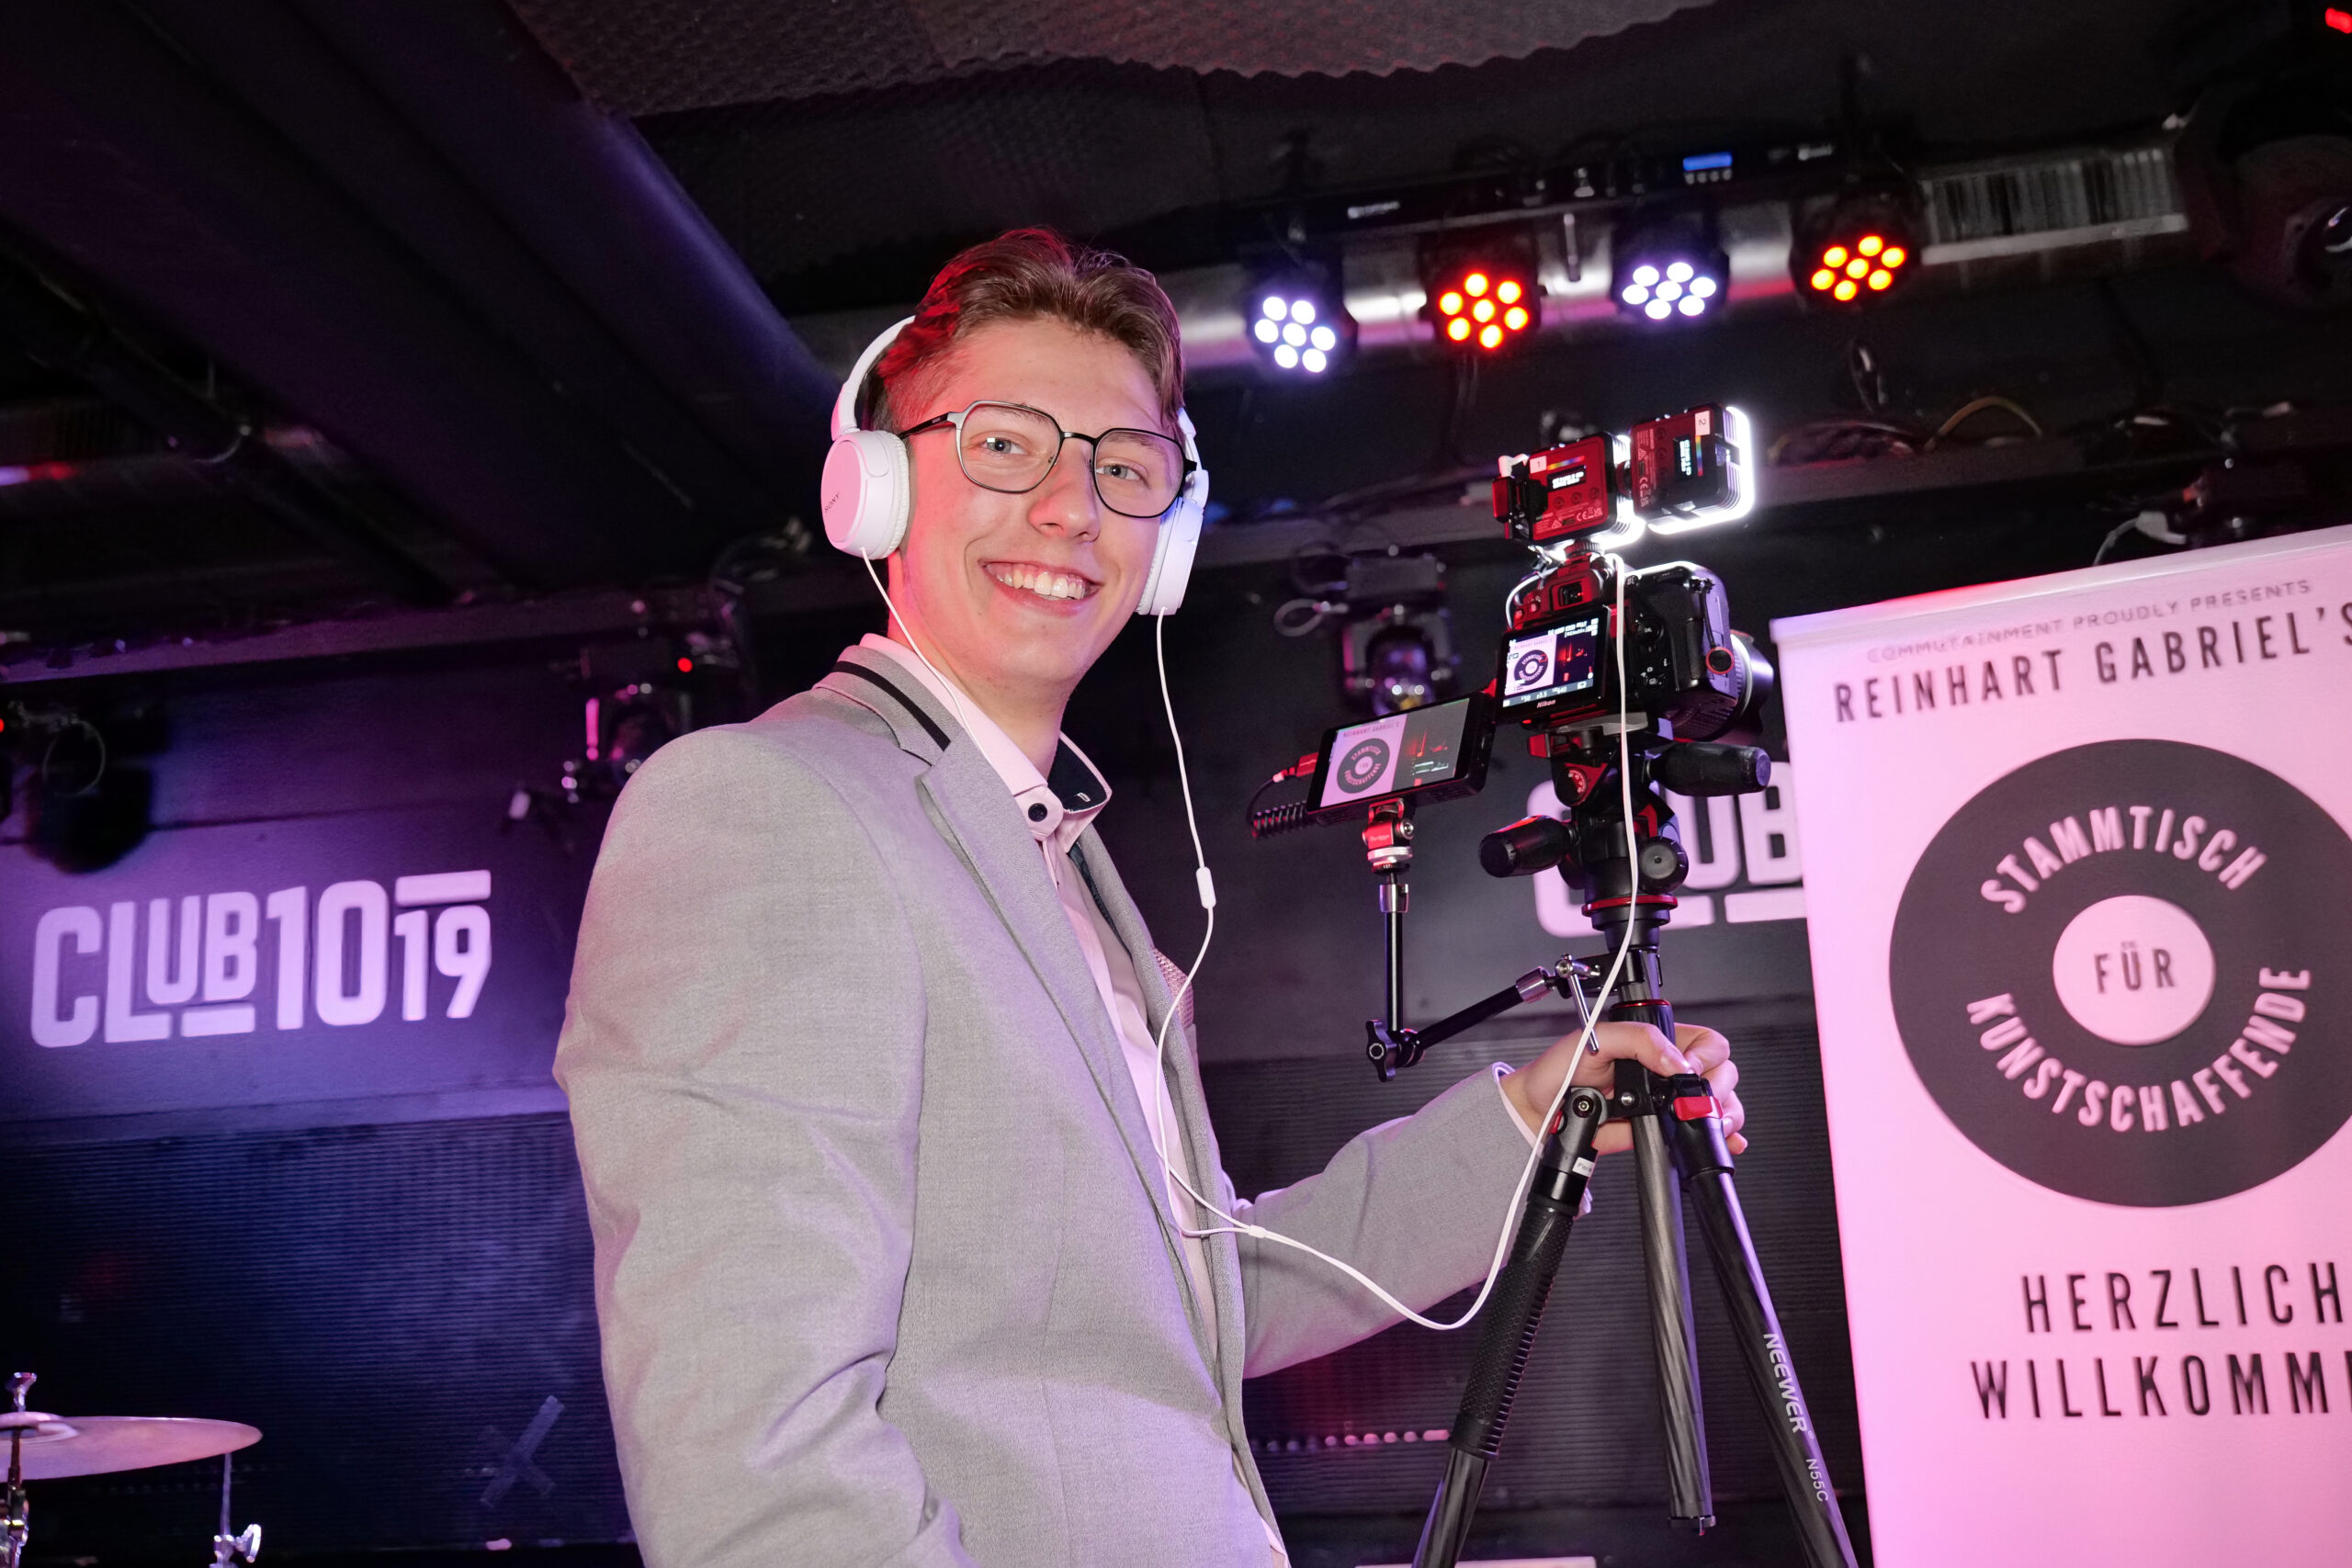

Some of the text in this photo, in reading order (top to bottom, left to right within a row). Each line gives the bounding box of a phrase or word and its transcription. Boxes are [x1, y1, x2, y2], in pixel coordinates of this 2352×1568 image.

[824, 491, 841, 513] SONY
[2073, 600, 2179, 631] PROUDLY
[2190, 579, 2311, 613] PRESENTS
[1536, 699, 1556, 709] Nikon
[1834, 649, 2064, 723] REINHART
[1981, 805, 2268, 914] STAMMTISCH
[2093, 940, 2177, 995] FÜR
[1966, 966, 2312, 1133] KUNSTSCHAFFENDE
[2021, 1261, 2344, 1333] HERZLICH
[1762, 1333, 1829, 1503] NEEWER N55C
[1970, 1350, 2352, 1419] WILLKOMM
